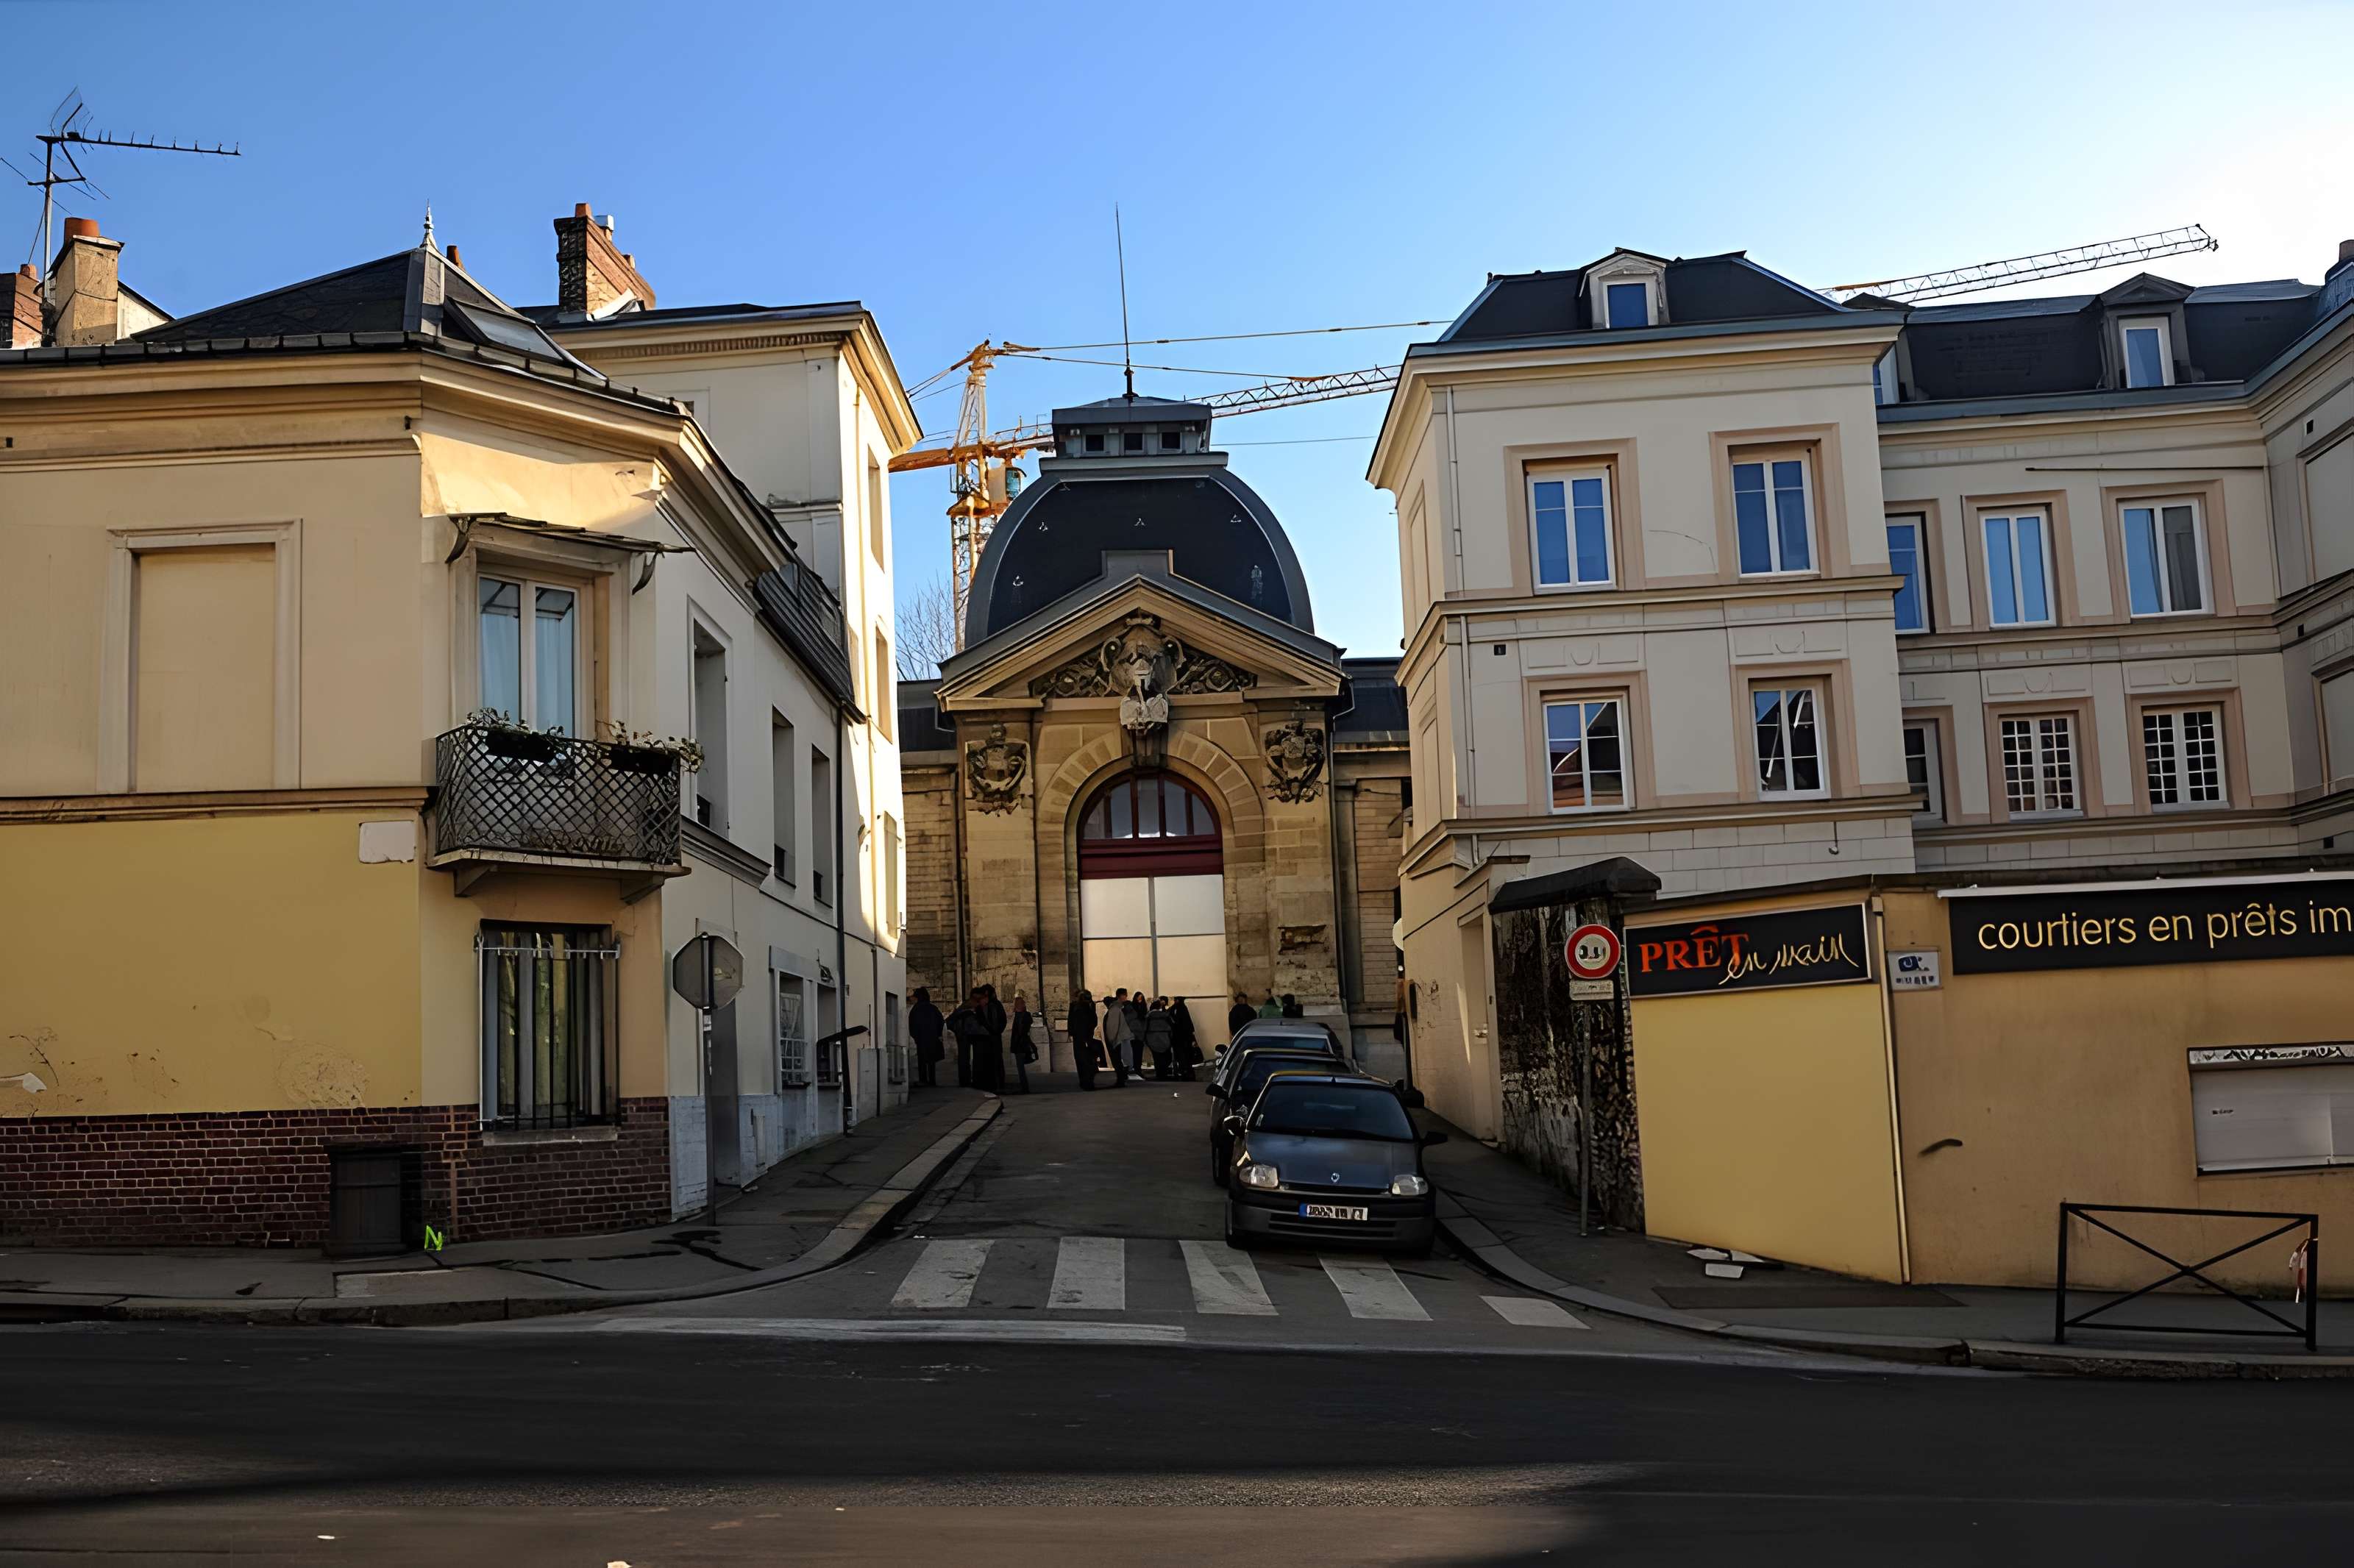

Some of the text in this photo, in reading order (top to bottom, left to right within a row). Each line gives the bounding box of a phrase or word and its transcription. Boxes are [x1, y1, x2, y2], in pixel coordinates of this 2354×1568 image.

[1638, 924, 1749, 973] PRÊT
[1978, 912, 2137, 950] courtiers
[2148, 916, 2193, 942] en
[2207, 902, 2297, 949] prêts
